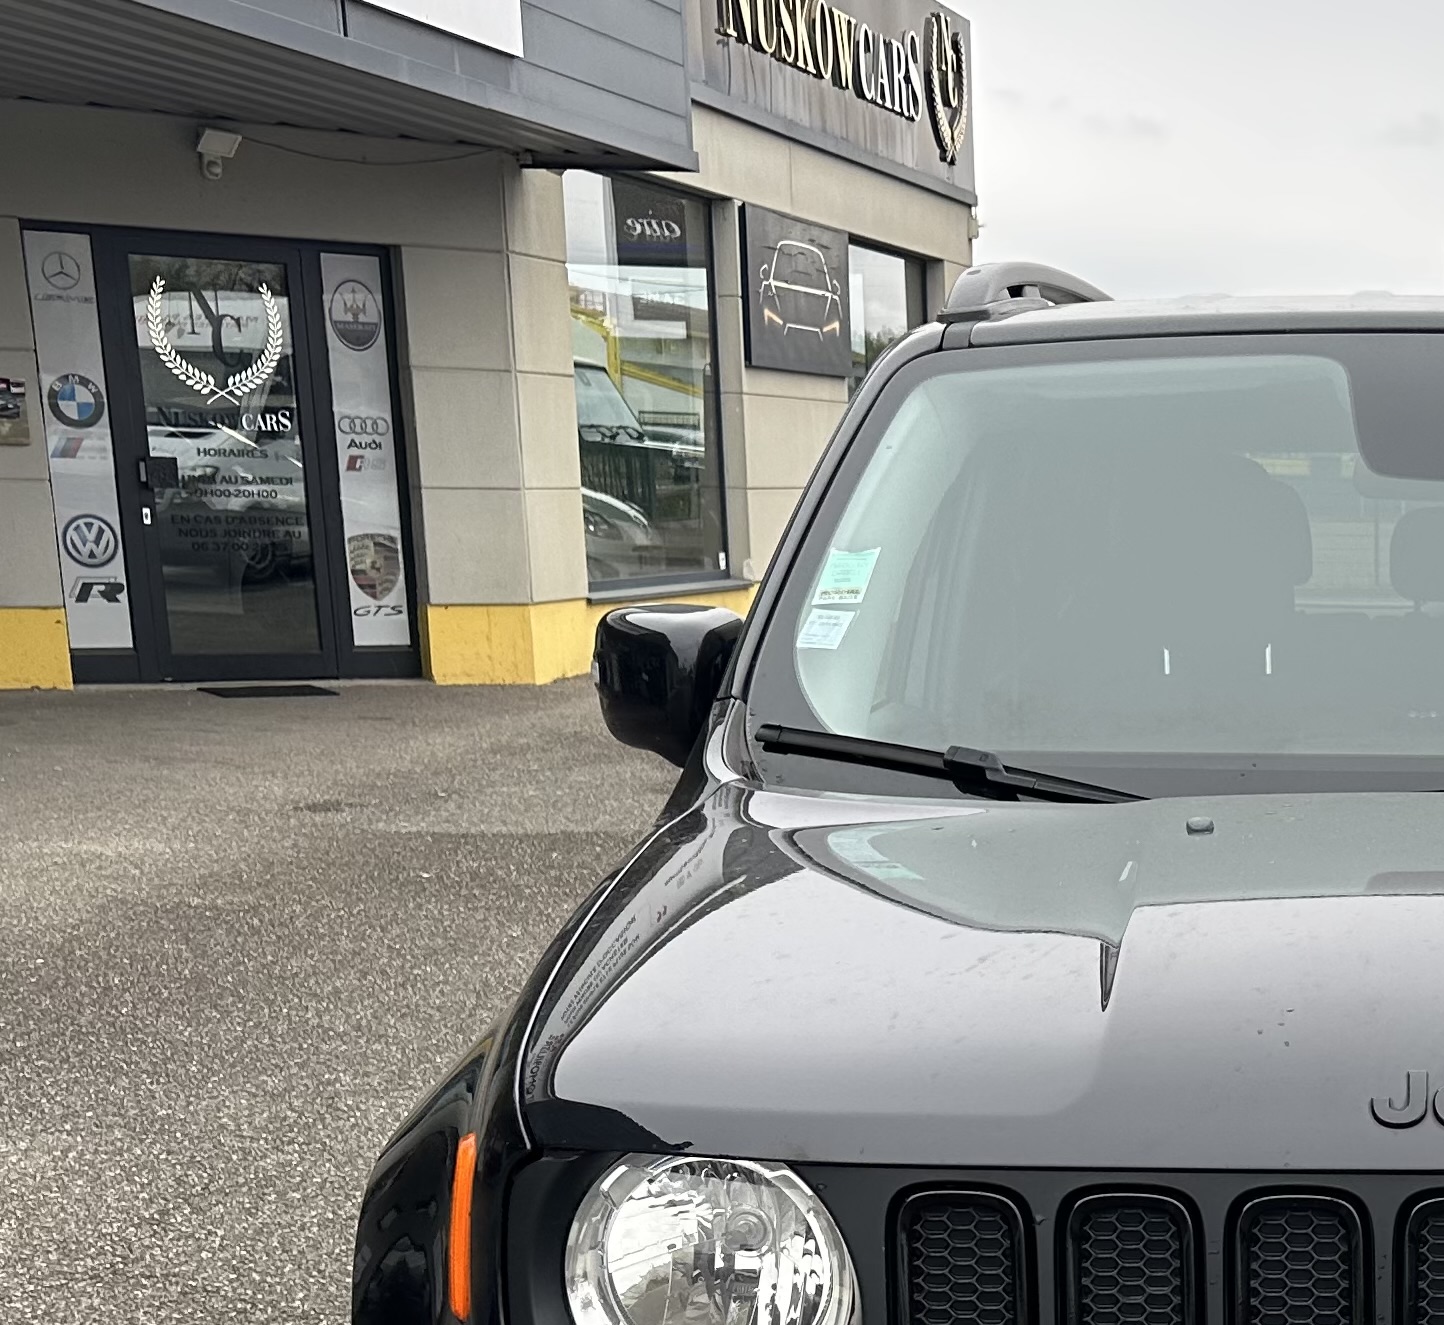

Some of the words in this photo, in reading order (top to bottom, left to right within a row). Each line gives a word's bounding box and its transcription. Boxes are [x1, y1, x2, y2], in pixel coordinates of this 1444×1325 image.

[858, 23, 922, 122] CARS
[51, 374, 99, 393] BMW
[241, 409, 293, 432] CARS
[347, 438, 383, 451] Audi
[196, 447, 269, 459] HORAIRES
[353, 605, 403, 616] GTS
